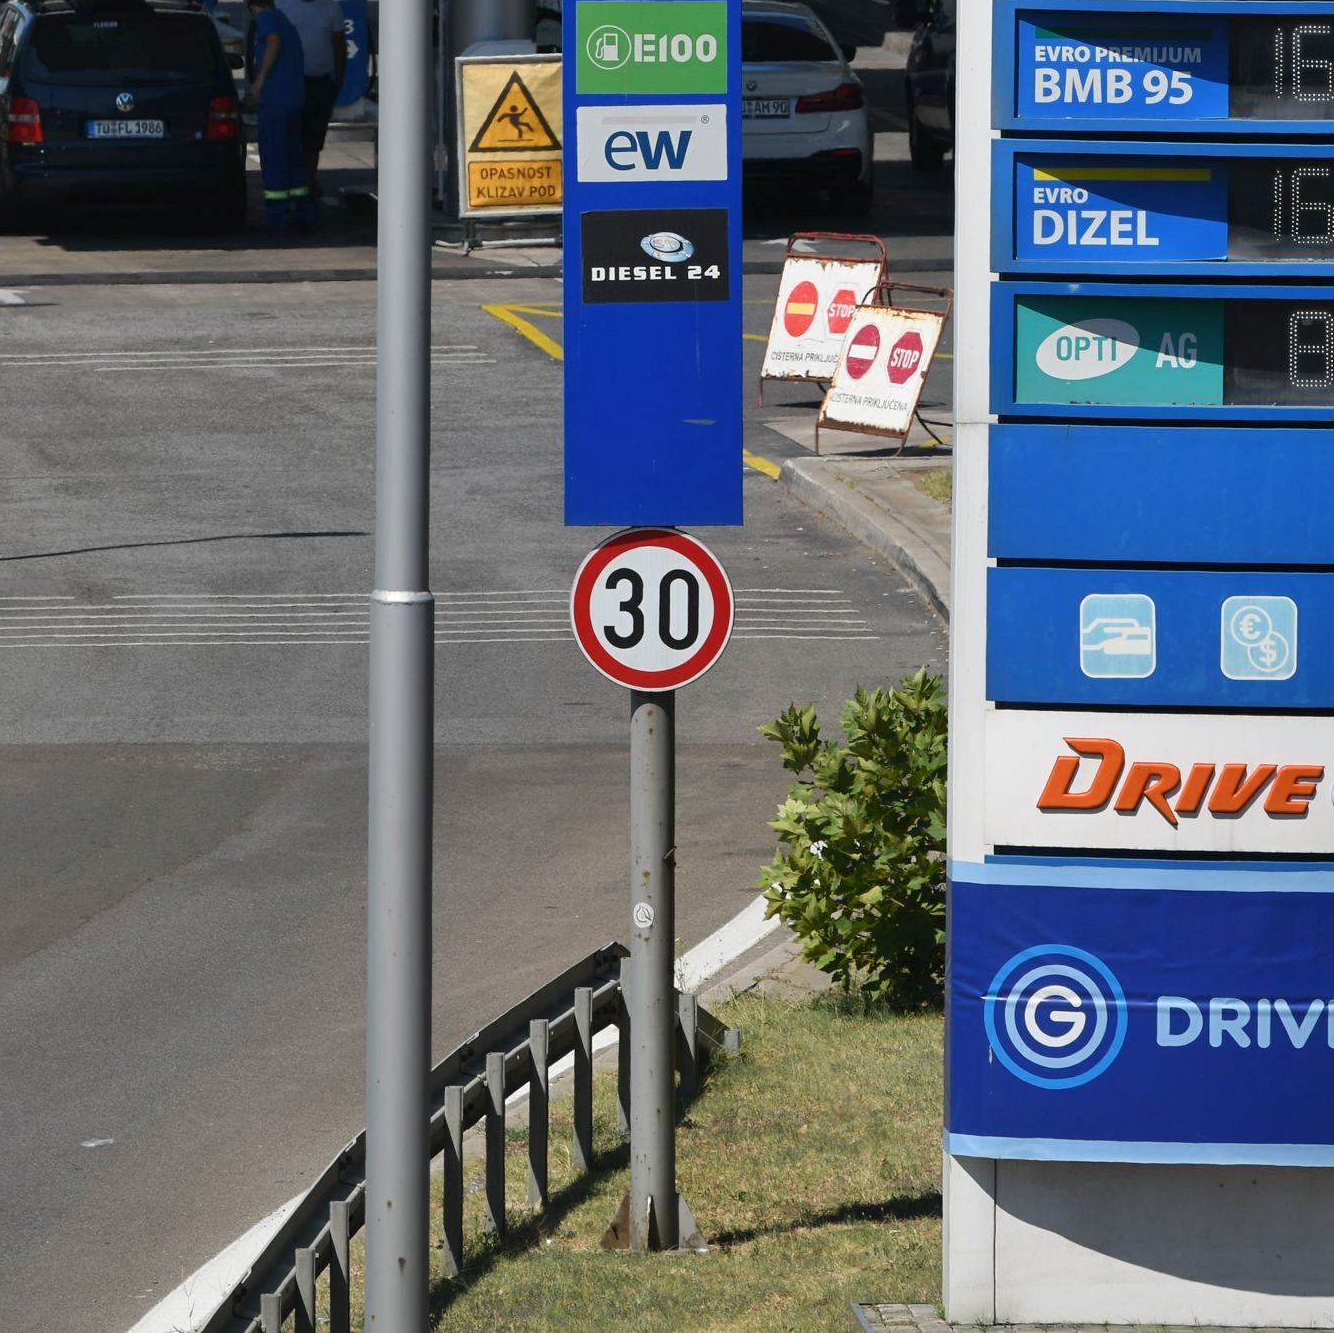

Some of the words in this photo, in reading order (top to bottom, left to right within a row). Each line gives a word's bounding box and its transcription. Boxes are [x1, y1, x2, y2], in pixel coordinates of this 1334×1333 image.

[634, 33, 717, 63] E100
[1034, 46, 1091, 64] EVRO
[1095, 46, 1202, 64] PREMIJUM
[1034, 69, 1133, 104] BMB
[1143, 69, 1194, 105] 95
[604, 129, 693, 171] ew
[480, 166, 552, 180] OPASNOST
[476, 186, 524, 199] KLIZAV
[529, 185, 556, 198] POD
[1033, 187, 1089, 205] EVRO
[1033, 210, 1159, 246] DIZEL
[591, 266, 677, 281] DIESEL
[688, 264, 721, 280] 24
[828, 303, 856, 318] STOP
[804, 352, 839, 364] PRIKLJUČ
[890, 348, 921, 368] STOP
[1056, 335, 1118, 363] OPTI
[1156, 333, 1197, 369] AG
[604, 567, 700, 650] 30
[1036, 737, 1324, 827] DRIVE
